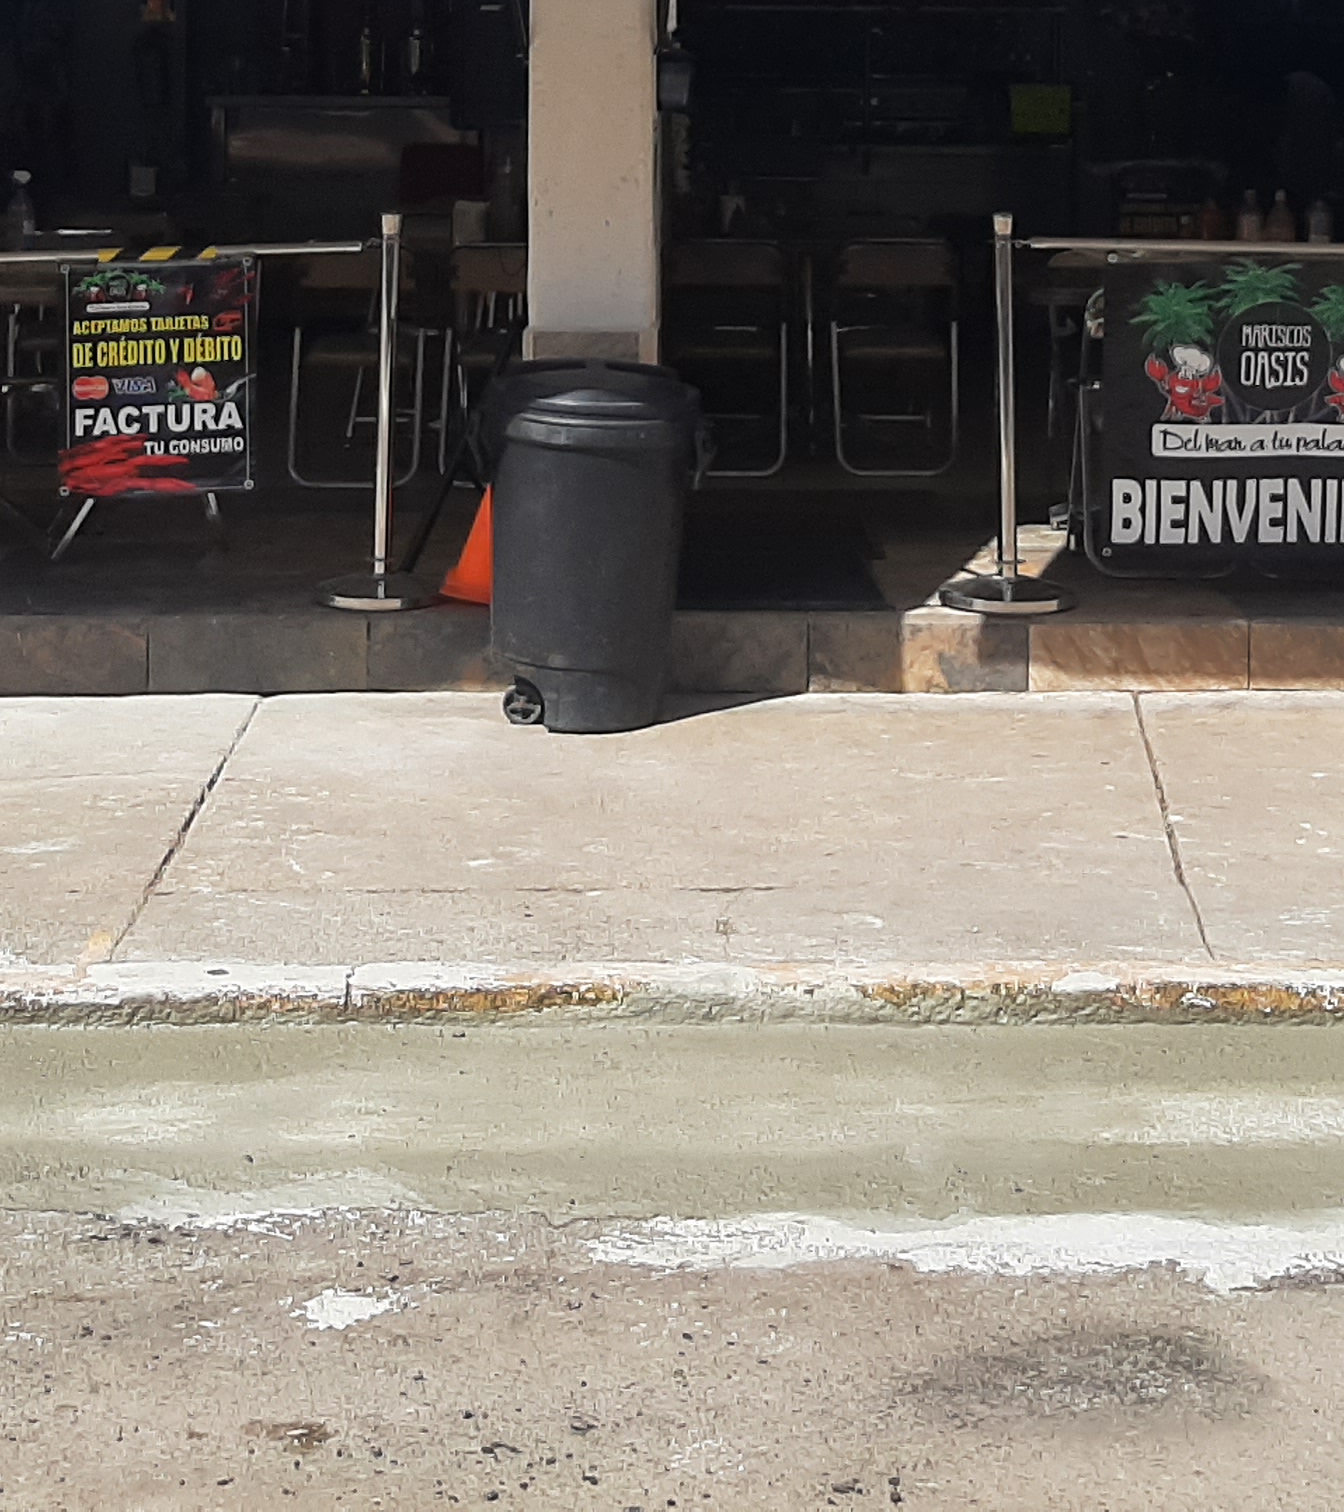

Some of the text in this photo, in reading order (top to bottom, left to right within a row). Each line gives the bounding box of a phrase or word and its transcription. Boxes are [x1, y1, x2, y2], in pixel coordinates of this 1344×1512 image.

[73, 316, 209, 335] ACEPTAMOS TARJETAS
[1241, 325, 1312, 348] MARISCOS
[73, 333, 243, 368] DE CRÉDITO Y DÉBITO
[1240, 351, 1309, 388] OASIS
[74, 402, 244, 437] FACTURA
[144, 437, 244, 456] TU CONSUMO
[1160, 429, 1201, 452] Del
[1250, 438, 1265, 452] a
